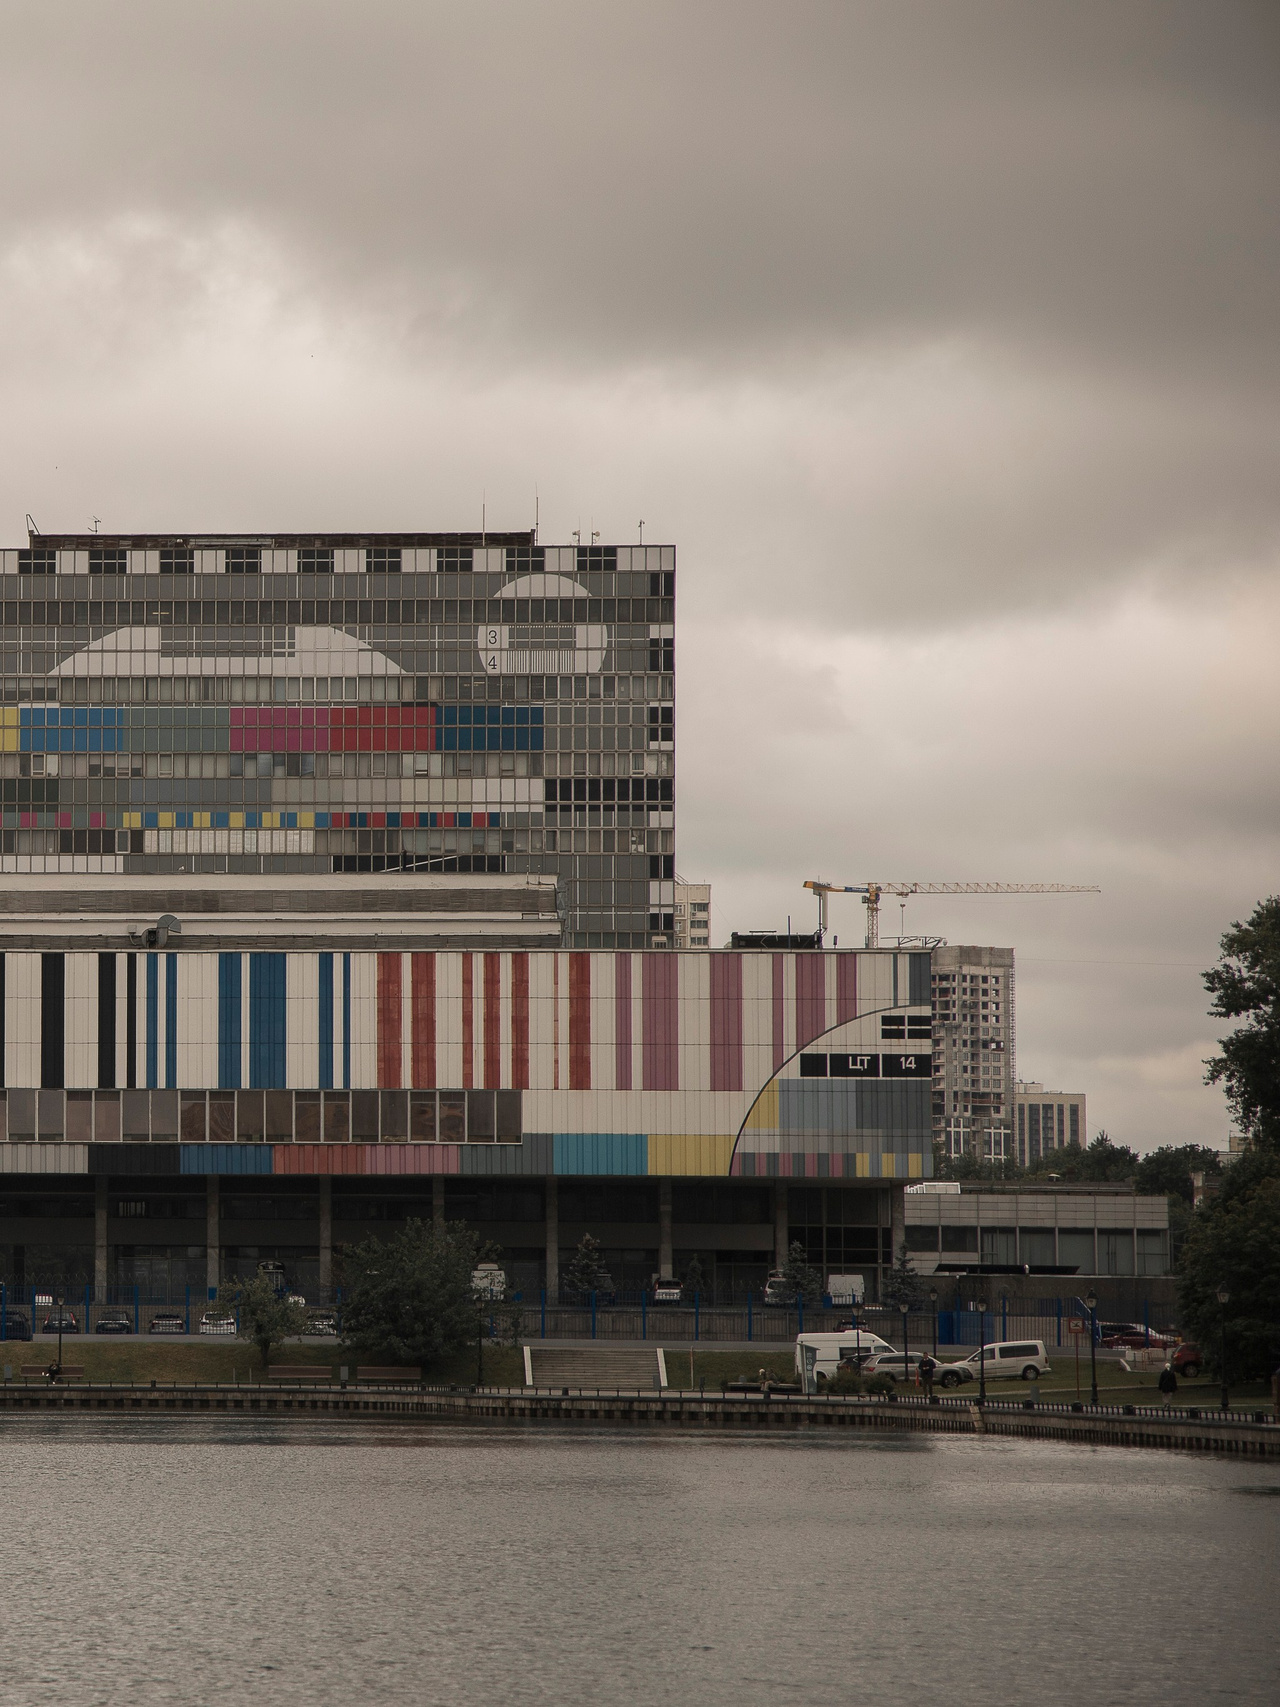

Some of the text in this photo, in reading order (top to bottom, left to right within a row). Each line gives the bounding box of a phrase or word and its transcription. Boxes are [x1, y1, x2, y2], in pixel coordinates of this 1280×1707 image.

[488, 630, 497, 645] 3
[488, 655, 497, 669] 4
[848, 1056, 917, 1072] ЦТ 14
